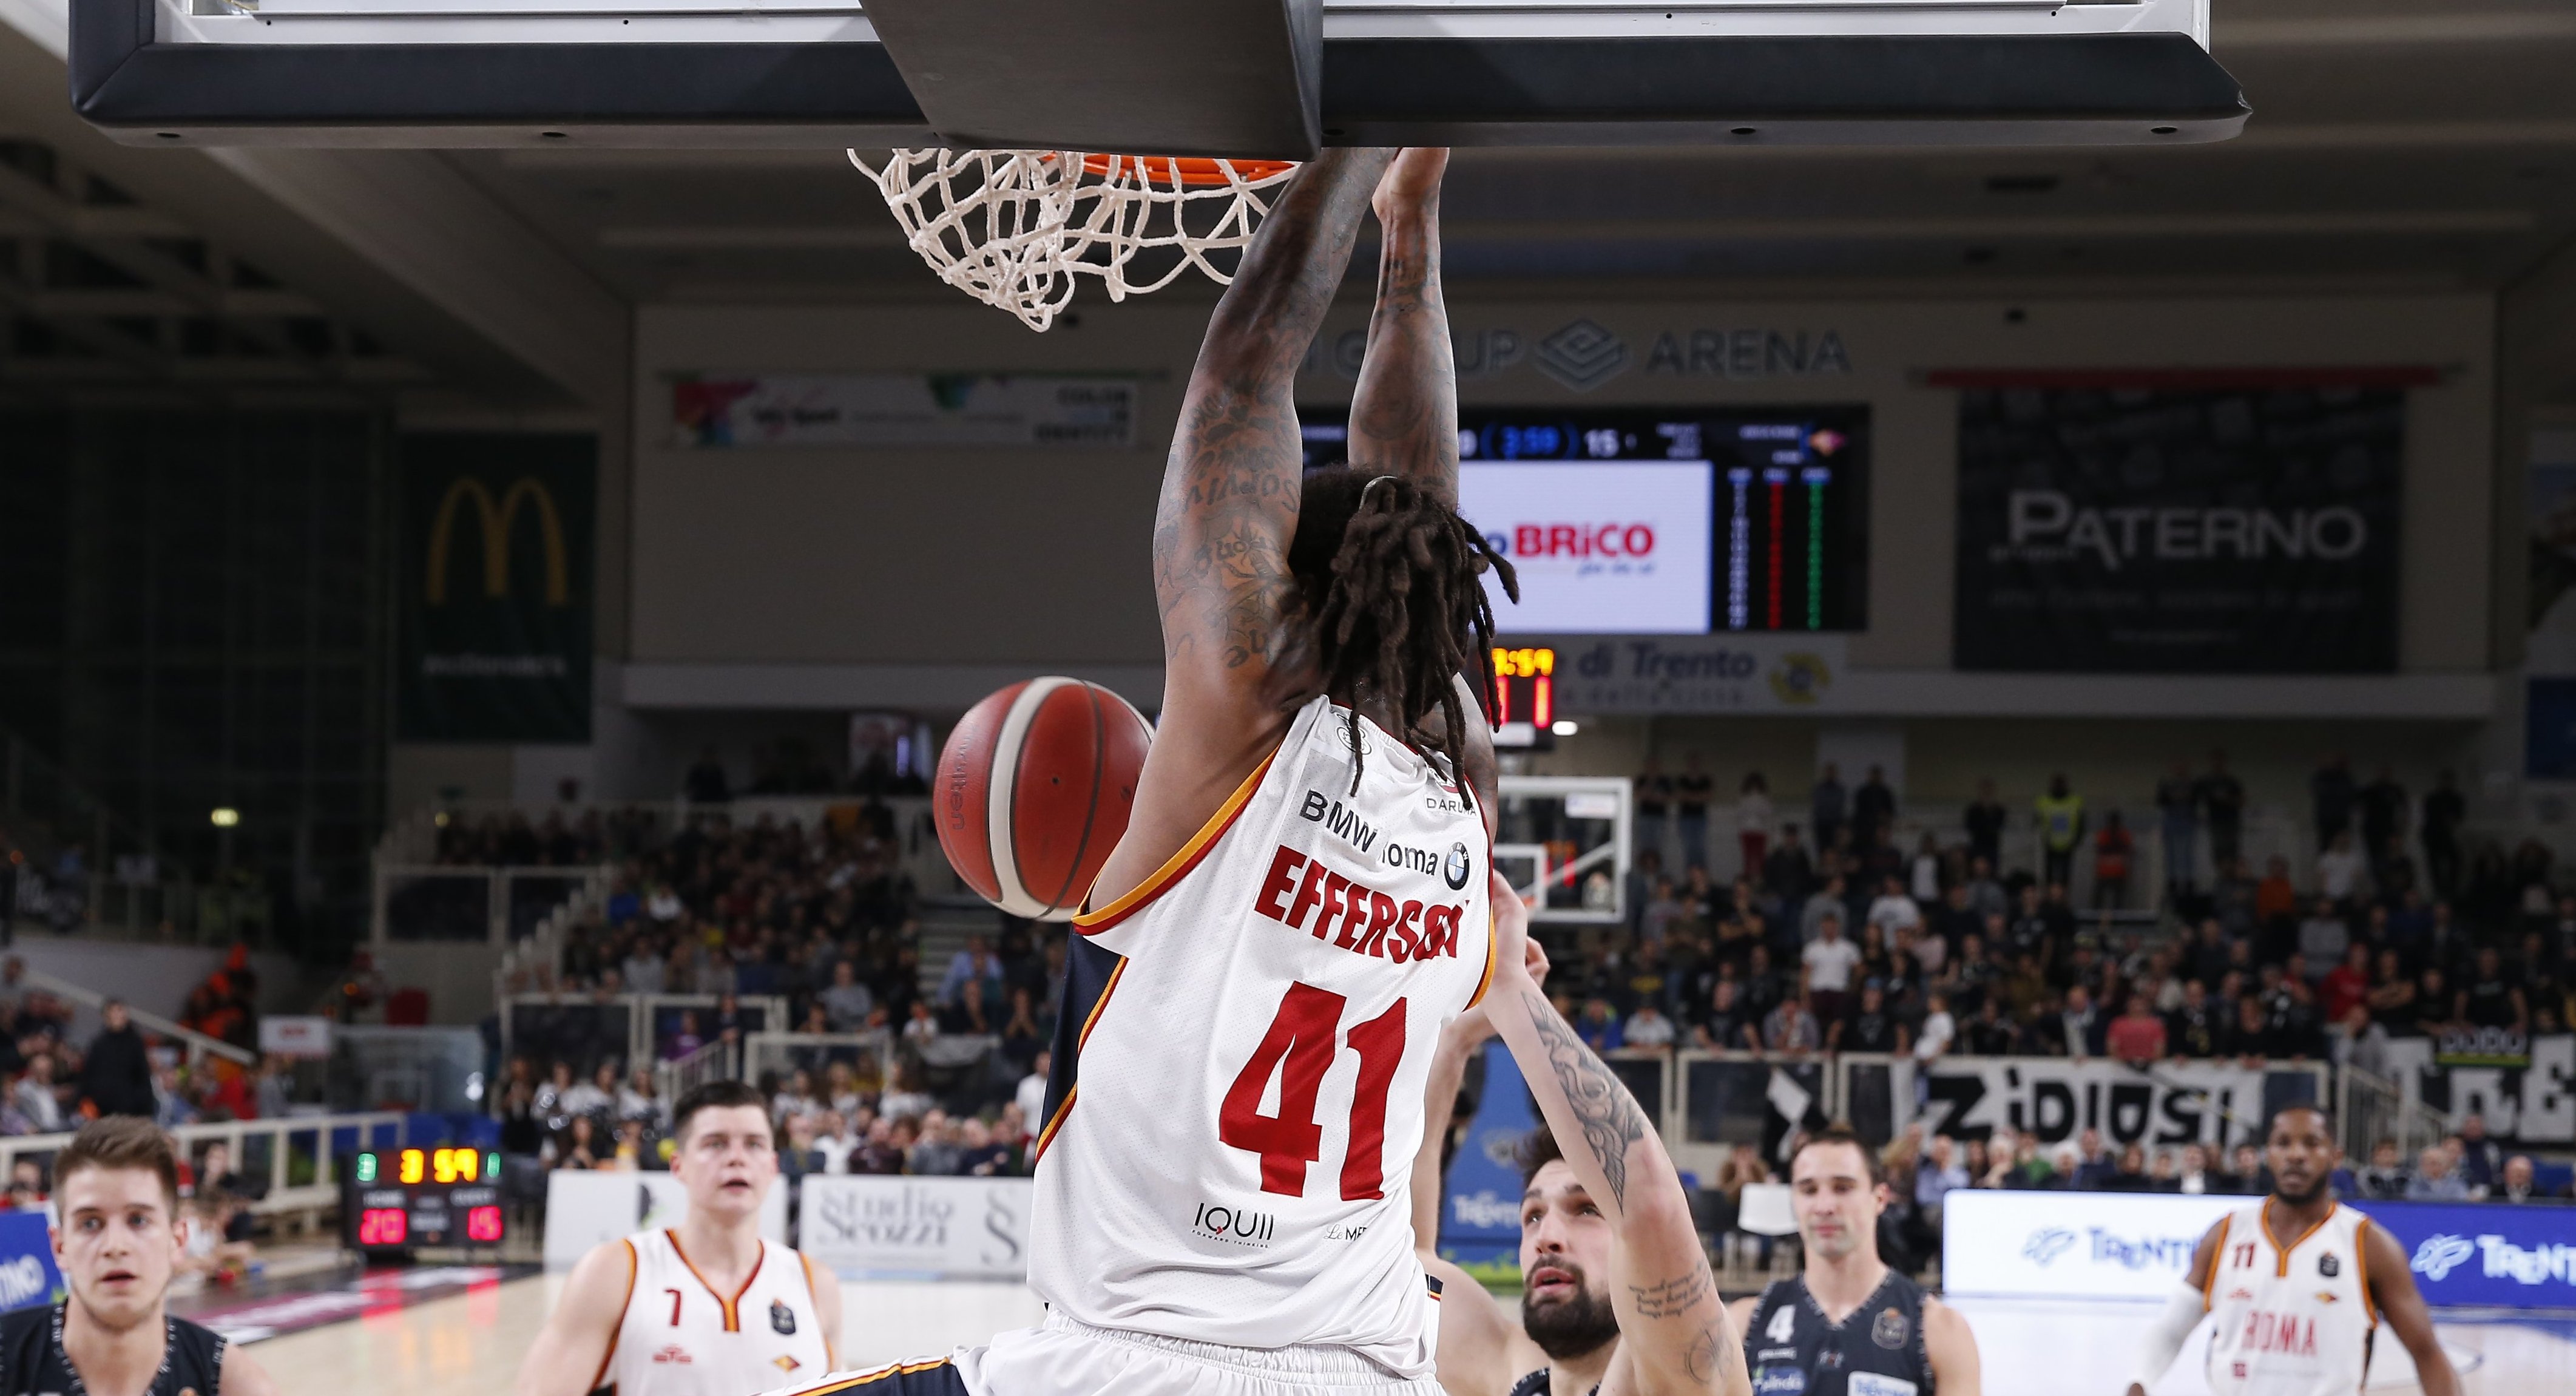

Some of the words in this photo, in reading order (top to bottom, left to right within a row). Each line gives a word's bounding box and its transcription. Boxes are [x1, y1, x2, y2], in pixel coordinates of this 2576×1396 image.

[1646, 331, 1853, 374] ARENA
[2007, 489, 2369, 571] PATERNO
[1578, 644, 1613, 677] di
[1629, 643, 1756, 679] Trento
[1299, 788, 1378, 853] BMW
[1382, 841, 1439, 876] oma
[1219, 980, 1407, 1201] 41
[1192, 1229, 1229, 1242] FORWARD
[1324, 1224, 1343, 1240] Le
[2088, 1227, 2193, 1270] TRENT
[2234, 1242, 2256, 1268] 11
[664, 1289, 681, 1326] 7
[1765, 1304, 1796, 1344] 4
[2242, 1311, 2317, 1355] ROMA
